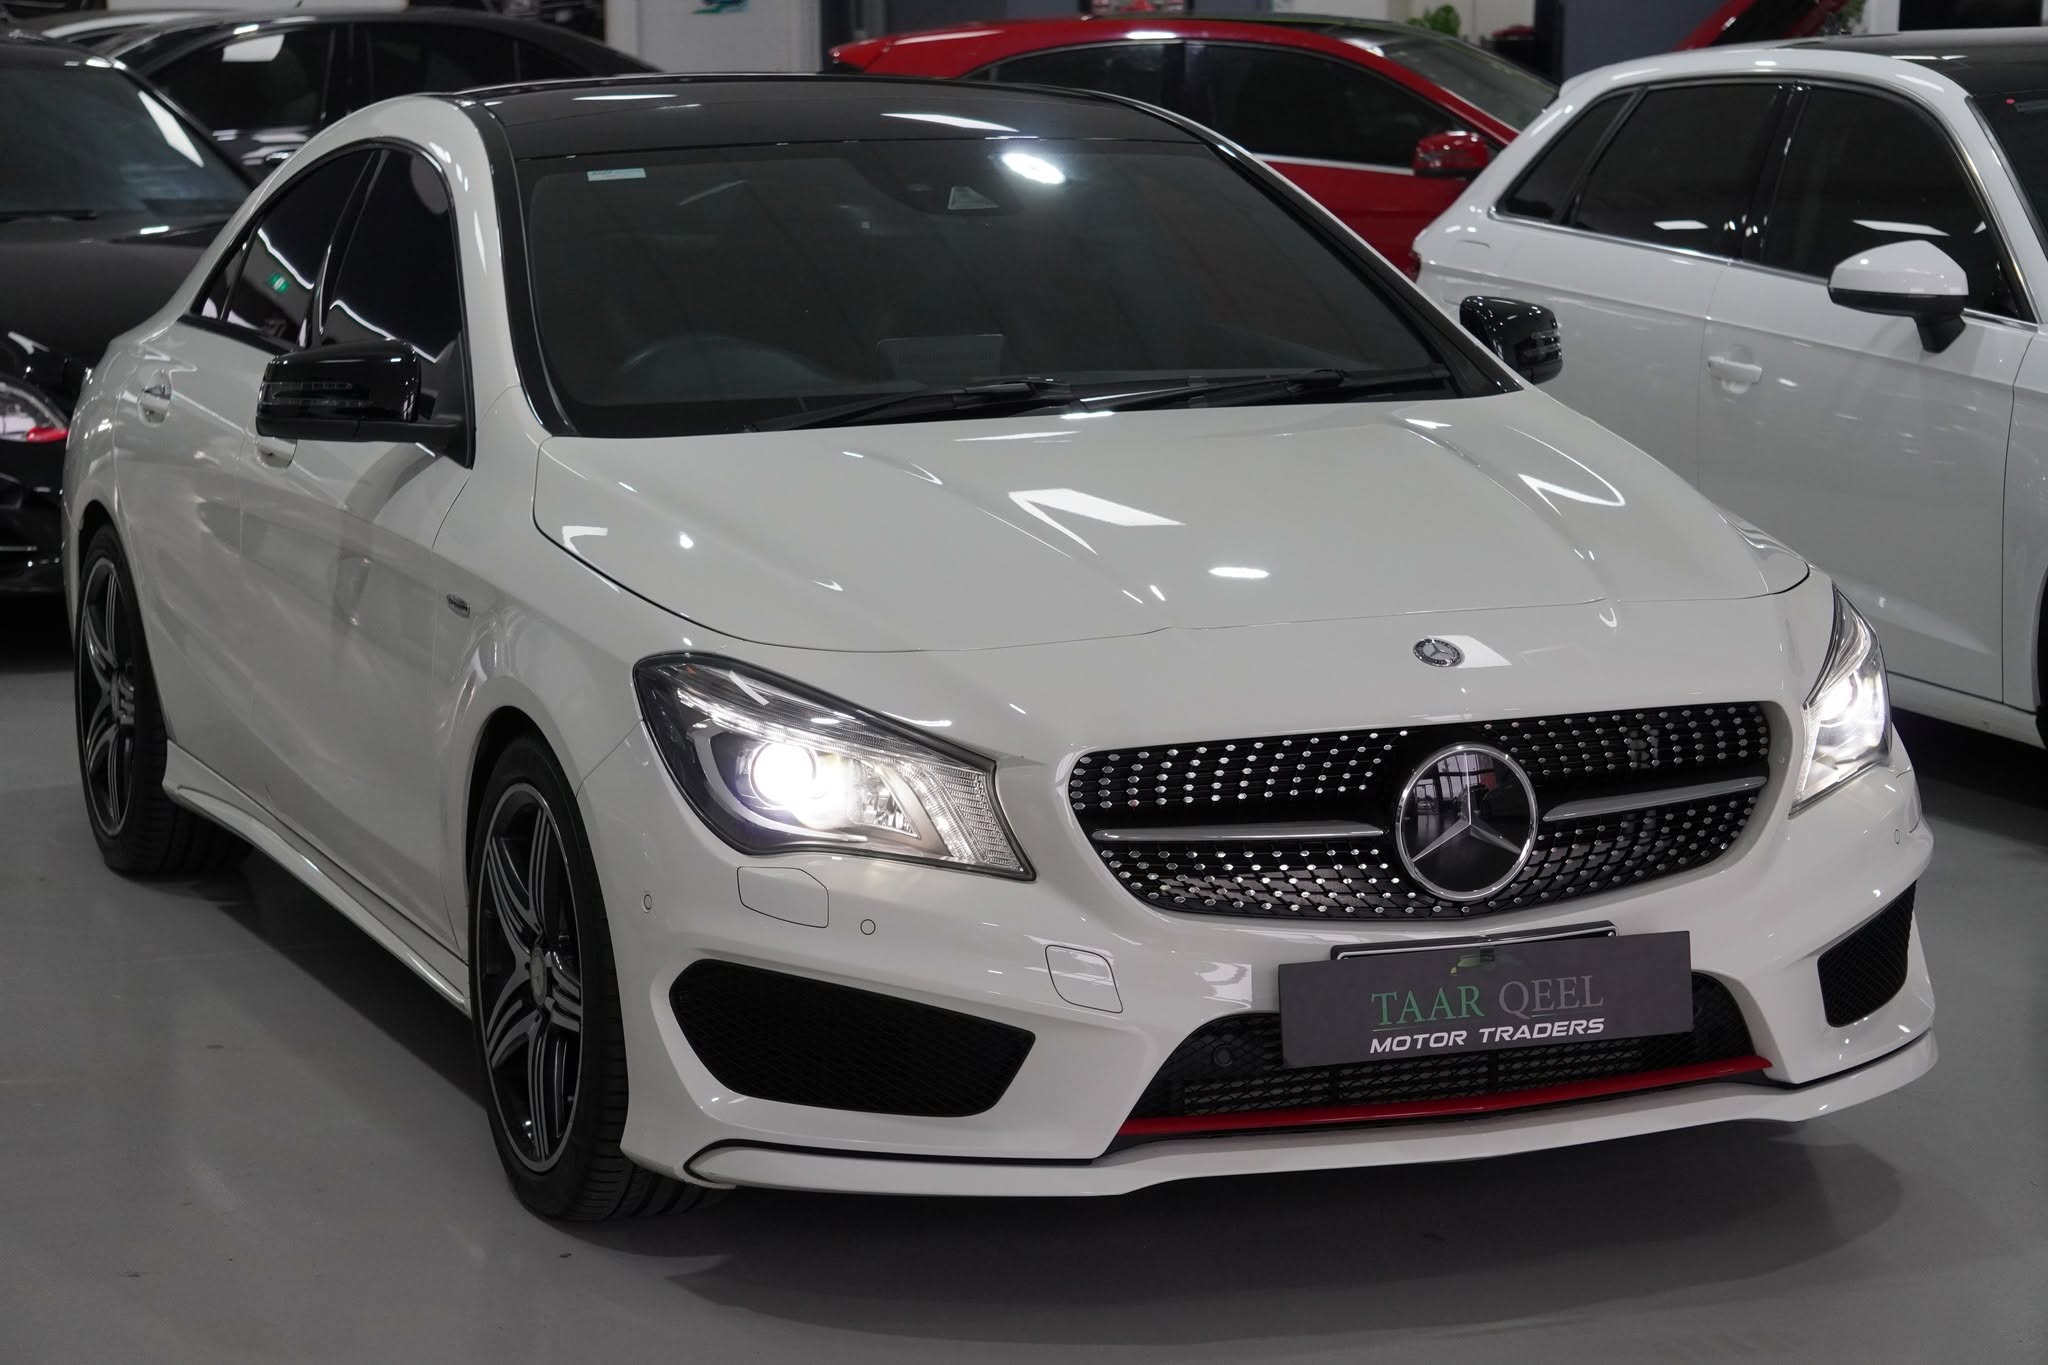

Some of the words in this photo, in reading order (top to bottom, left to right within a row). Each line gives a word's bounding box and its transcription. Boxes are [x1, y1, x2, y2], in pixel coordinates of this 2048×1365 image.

[1371, 985, 1485, 1025] TAAR
[1498, 975, 1605, 1019] QEEL
[1369, 1030, 1468, 1054] MOTOR
[1479, 1018, 1606, 1043] TRADERS
